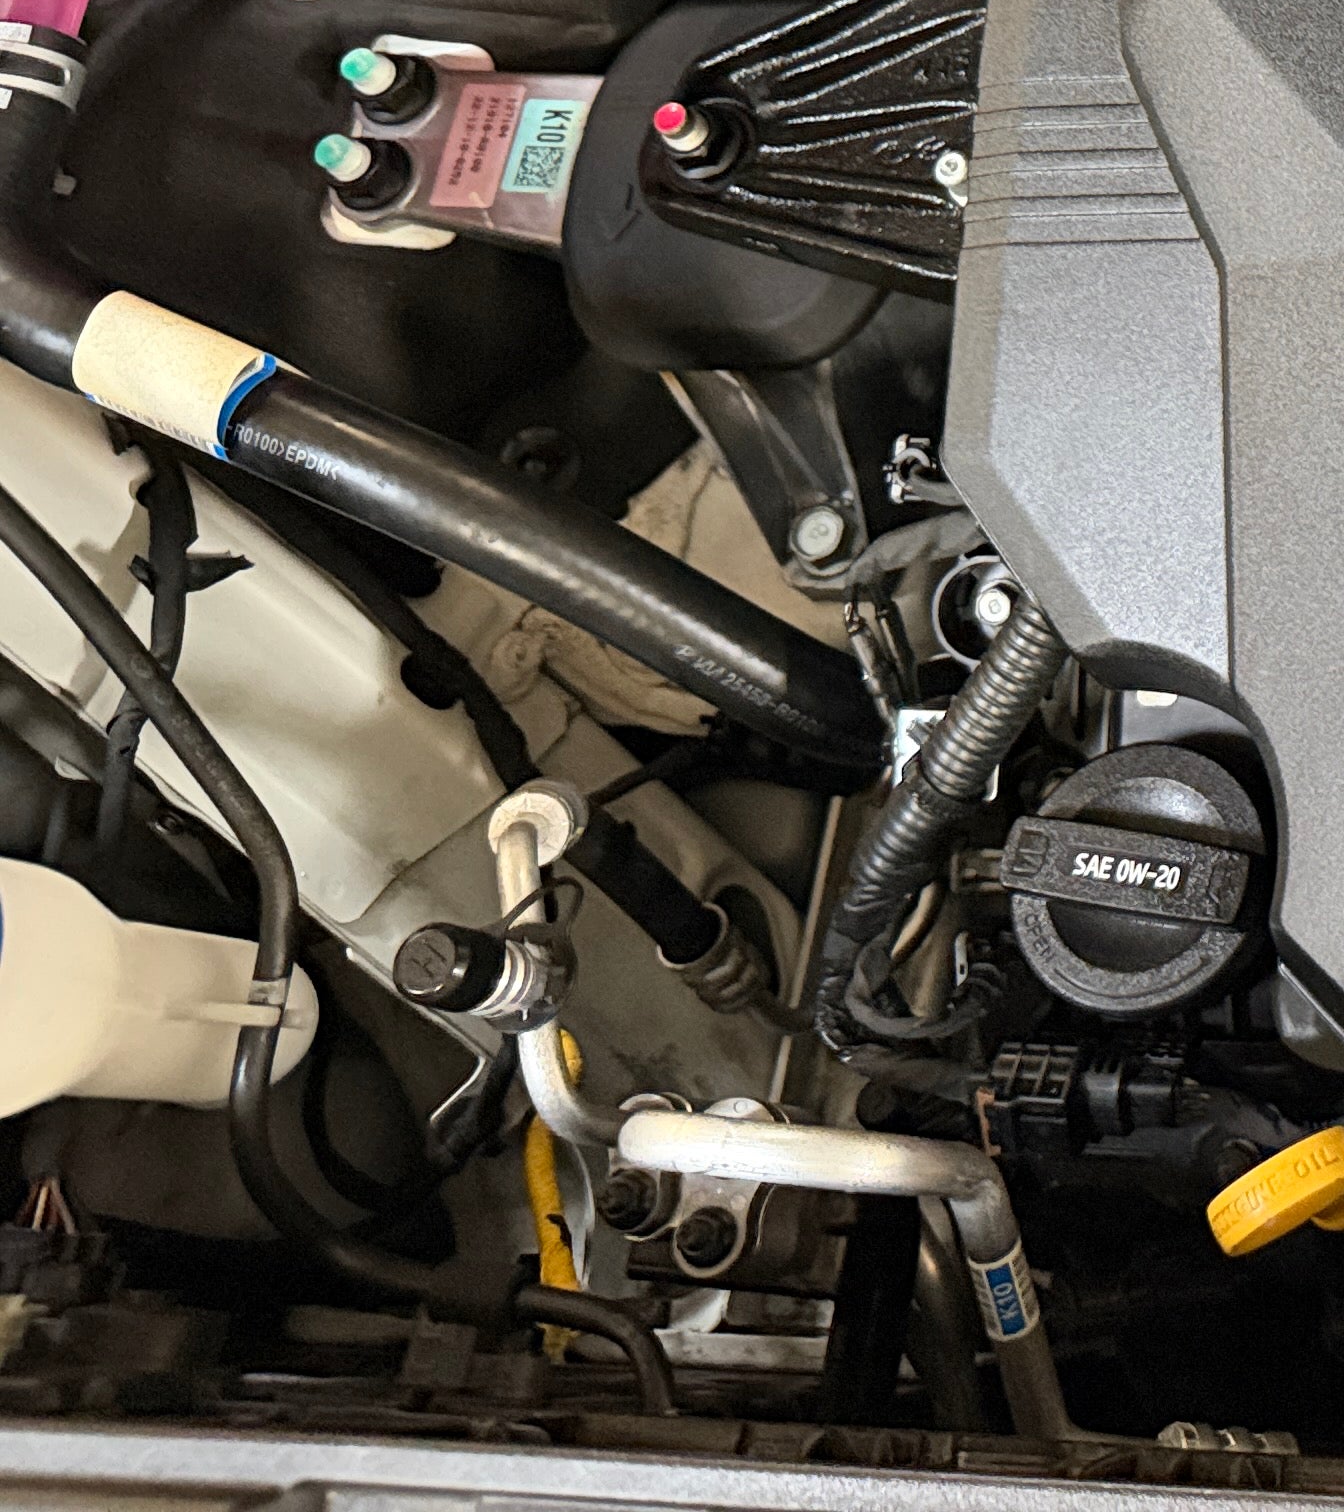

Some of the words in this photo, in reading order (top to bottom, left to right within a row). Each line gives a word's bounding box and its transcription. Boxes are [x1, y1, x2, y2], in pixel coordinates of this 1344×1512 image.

[536, 109, 574, 143] K10
[1072, 852, 1115, 881] SAE
[1116, 857, 1181, 891] 0W-20
[1293, 1146, 1341, 1179] OIL
